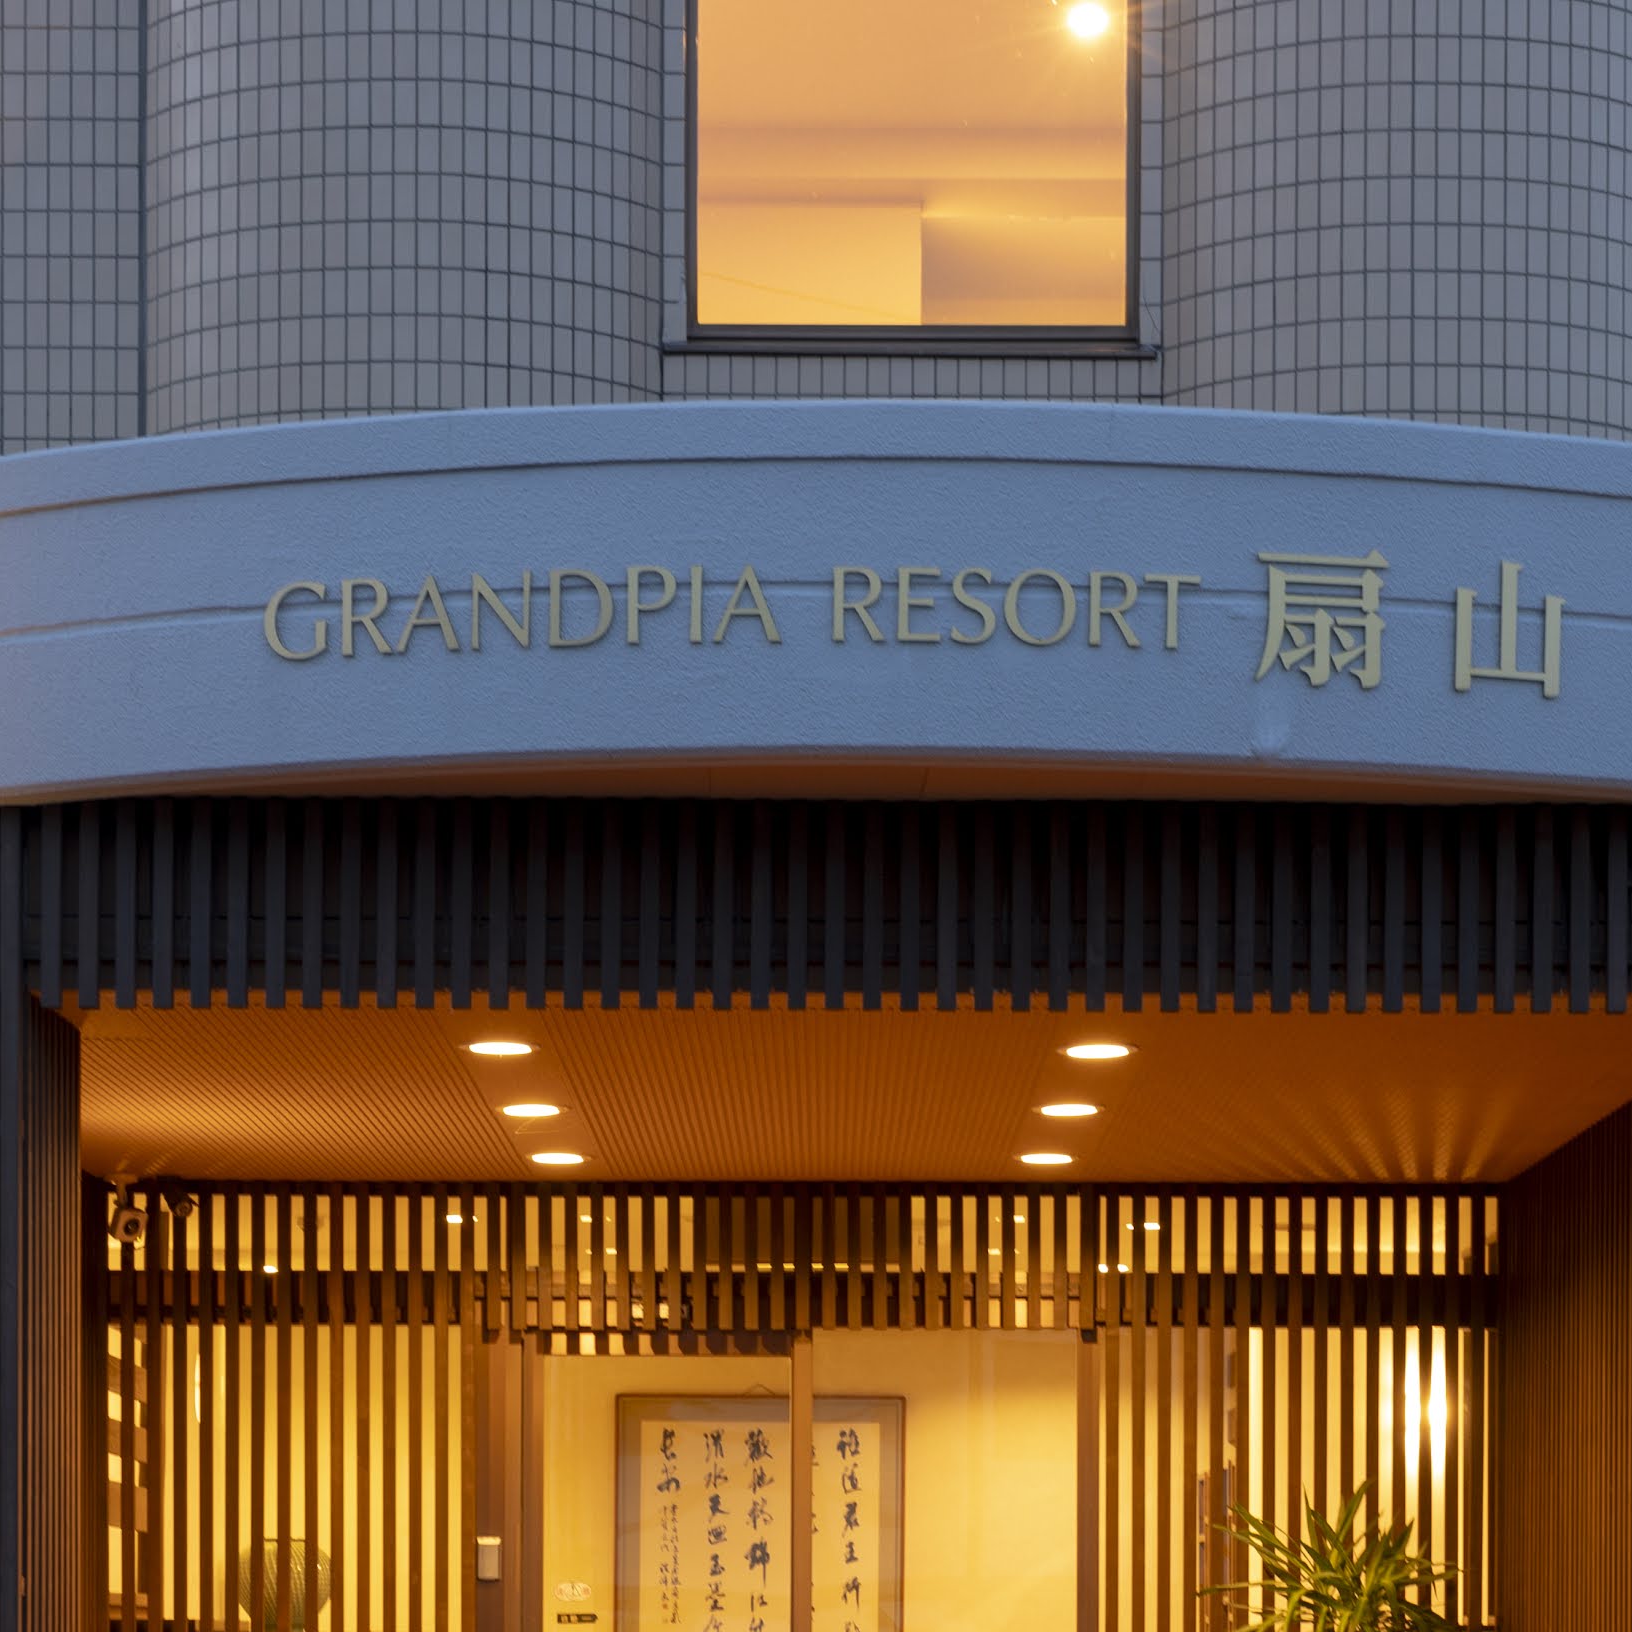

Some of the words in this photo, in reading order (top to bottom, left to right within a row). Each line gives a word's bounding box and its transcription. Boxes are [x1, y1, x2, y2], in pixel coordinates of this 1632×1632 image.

[263, 564, 783, 662] GRANDPIA
[831, 566, 1203, 650] RESORT
[1254, 548, 1568, 701] 扇山
